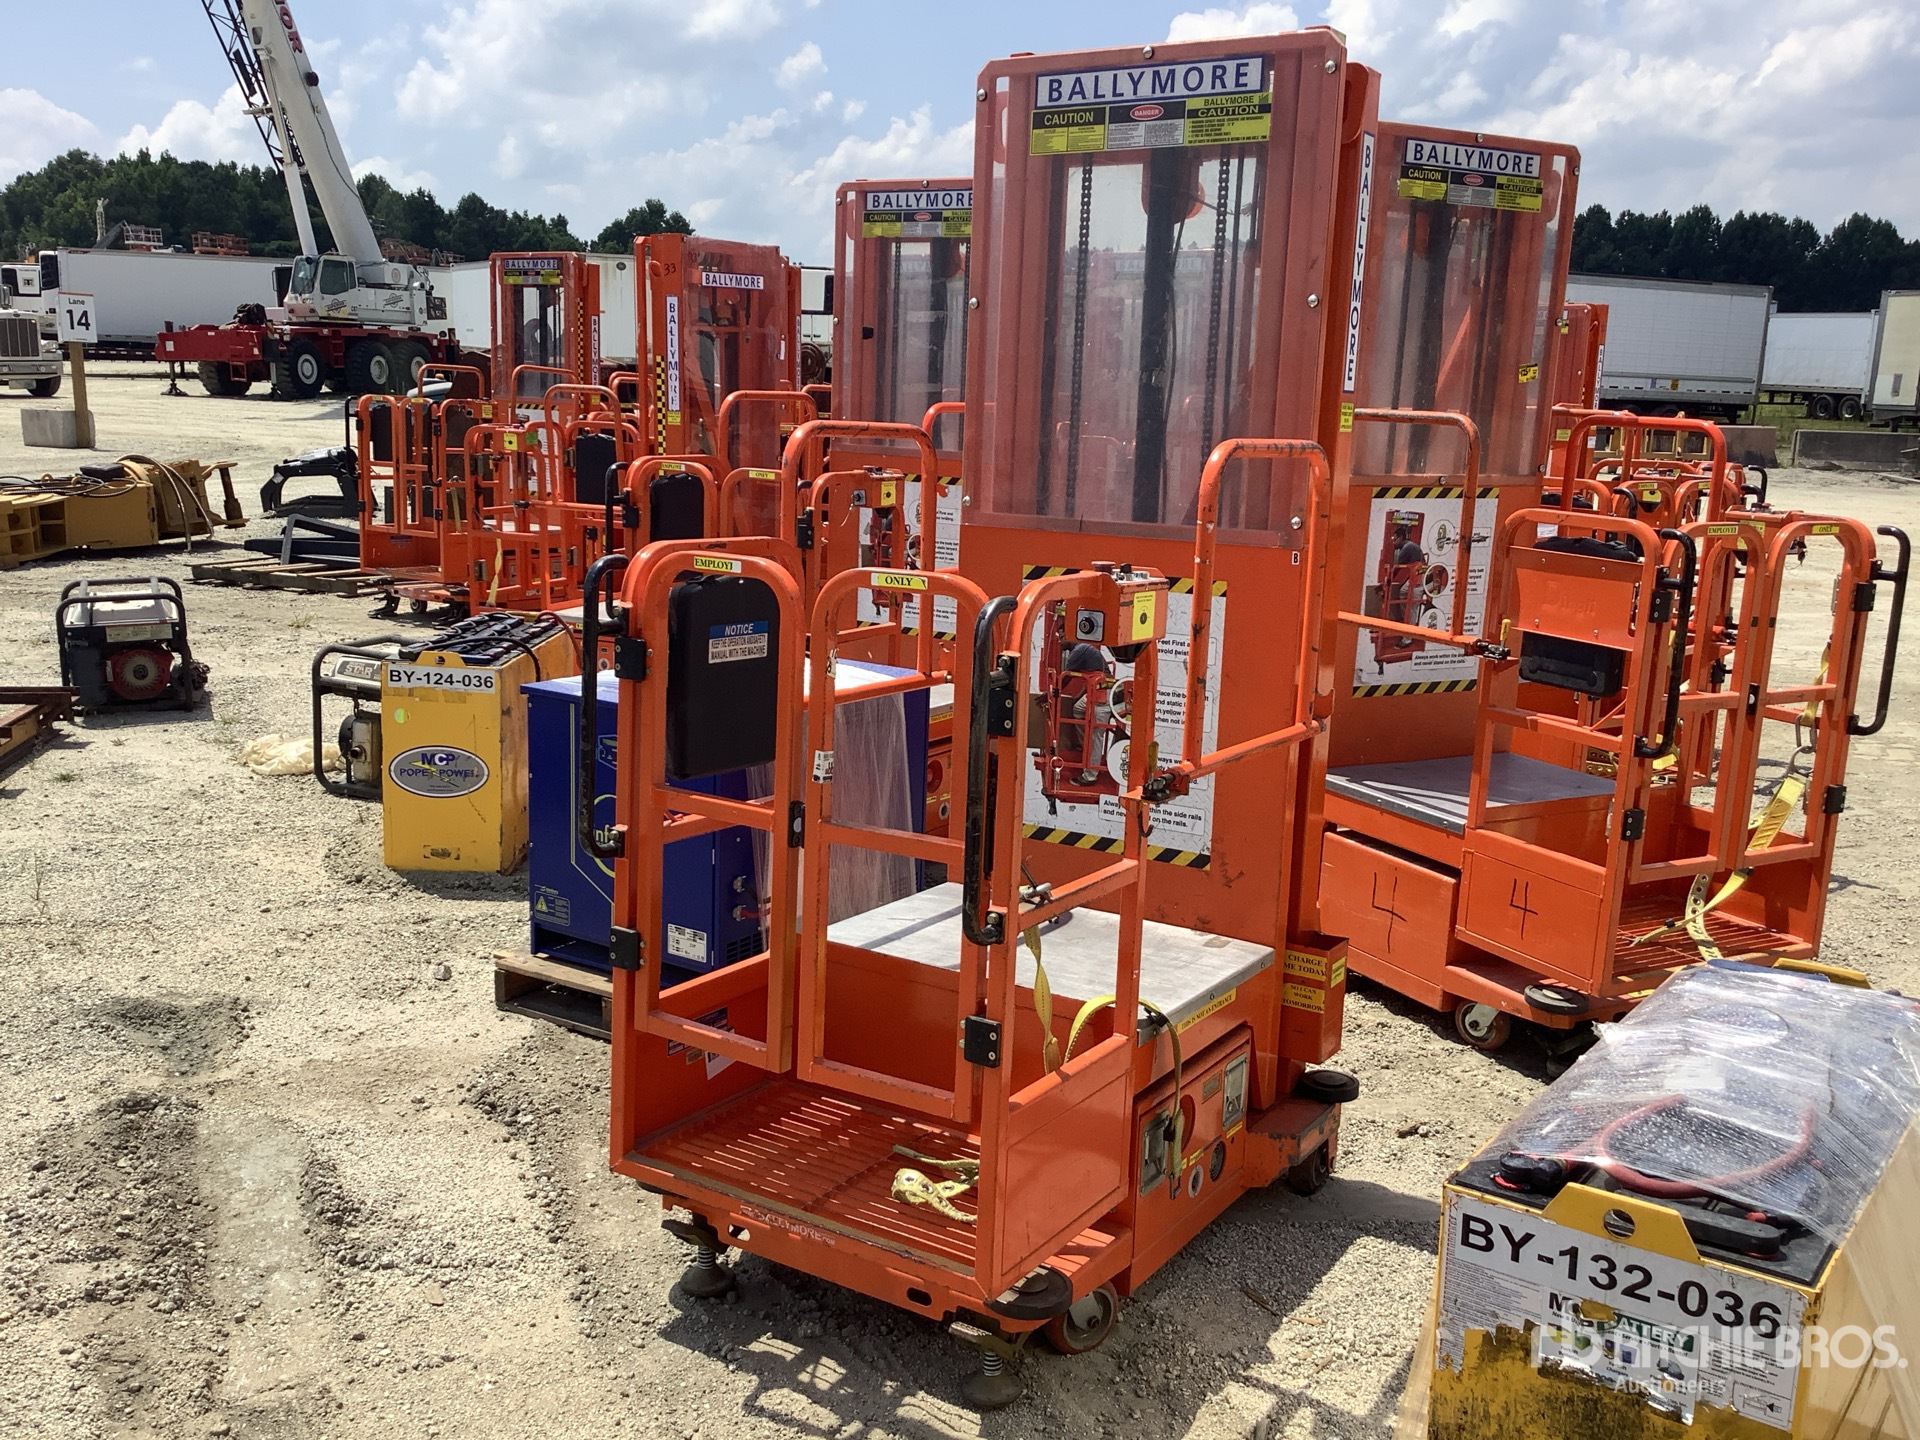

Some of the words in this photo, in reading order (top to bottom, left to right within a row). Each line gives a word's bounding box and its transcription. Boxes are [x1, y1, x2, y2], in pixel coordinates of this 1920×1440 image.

[1048, 62, 1250, 102] BALLYMORE
[1203, 95, 1255, 106] BALLYMORE
[1197, 105, 1259, 117] CAUTION
[1043, 111, 1094, 126] CAUTION
[1413, 143, 1534, 174] BALLYMORE
[1408, 169, 1441, 180] CAUTION
[1502, 185, 1537, 193] CAUTION
[505, 260, 557, 268] BALLYMORE
[1347, 145, 1371, 381] BALLYMORE
[705, 273, 761, 288] BALLYMORE
[68, 297, 85, 305] Lane
[66, 309, 91, 331] 14
[1294, 553, 1299, 563] B
[885, 575, 914, 586] ONLY
[725, 623, 754, 636] NOTICE
[720, 638, 728, 648] THE
[728, 636, 746, 647] OPERATION
[711, 649, 728, 660] MANUAL
[728, 648, 739, 658] WITH
[739, 647, 747, 657] THE
[747, 644, 766, 655] MACHINE
[345, 664, 373, 678] STAR
[389, 669, 494, 689] BY-124-036
[1162, 708, 1181, 716] yellow
[421, 752, 456, 766] MCP
[400, 768, 429, 777] POPE
[1103, 807, 1114, 816] and
[1161, 815, 1172, 825] the
[1173, 818, 1188, 828] rails.
[1162, 807, 1172, 816] the
[1173, 809, 1187, 818] side
[1188, 811, 1202, 820] rails
[1372, 872, 1407, 953] 4
[1509, 878, 1538, 940] 4
[1287, 954, 1323, 967] CHARGE
[1284, 962, 1295, 970] ME
[1297, 964, 1326, 976] TODAY
[1293, 991, 1313, 1001] WORK
[1282, 998, 1322, 1012] TOMORROW
[1461, 1212, 1783, 1339] BY-132-036
[1606, 1316, 1689, 1348] ATTERY
